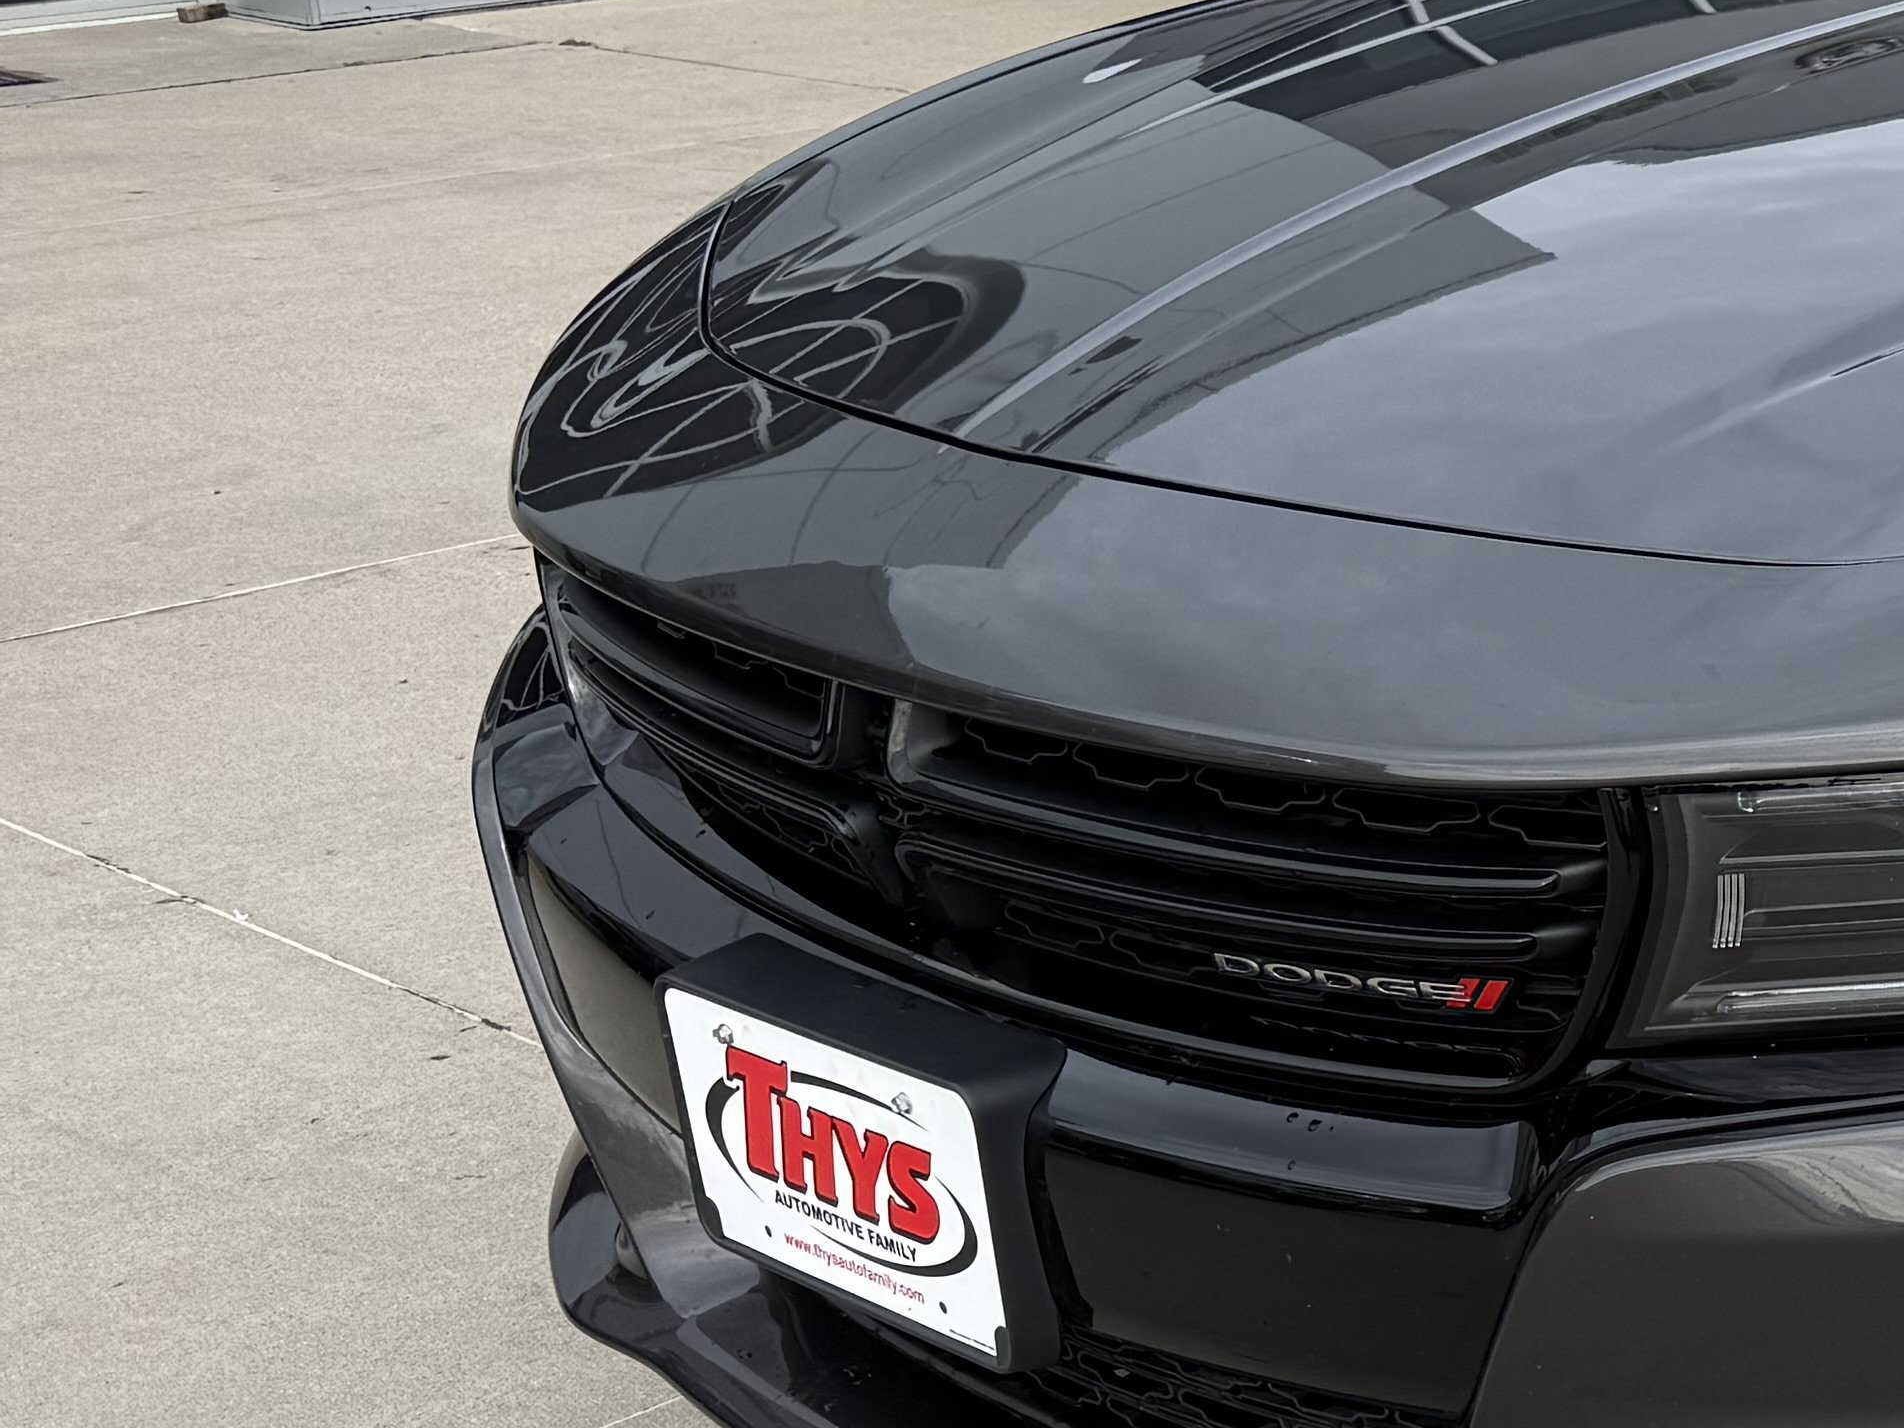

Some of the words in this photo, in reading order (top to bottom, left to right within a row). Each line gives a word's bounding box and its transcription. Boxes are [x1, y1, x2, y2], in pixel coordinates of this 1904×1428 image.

[1213, 952, 1470, 1003] DODGE
[725, 1044, 942, 1247] THYS
[774, 1189, 865, 1241] AUTOMOTIVE
[867, 1228, 917, 1263] FAMILY
[783, 1232, 925, 1305] www.thysautofamily.com
